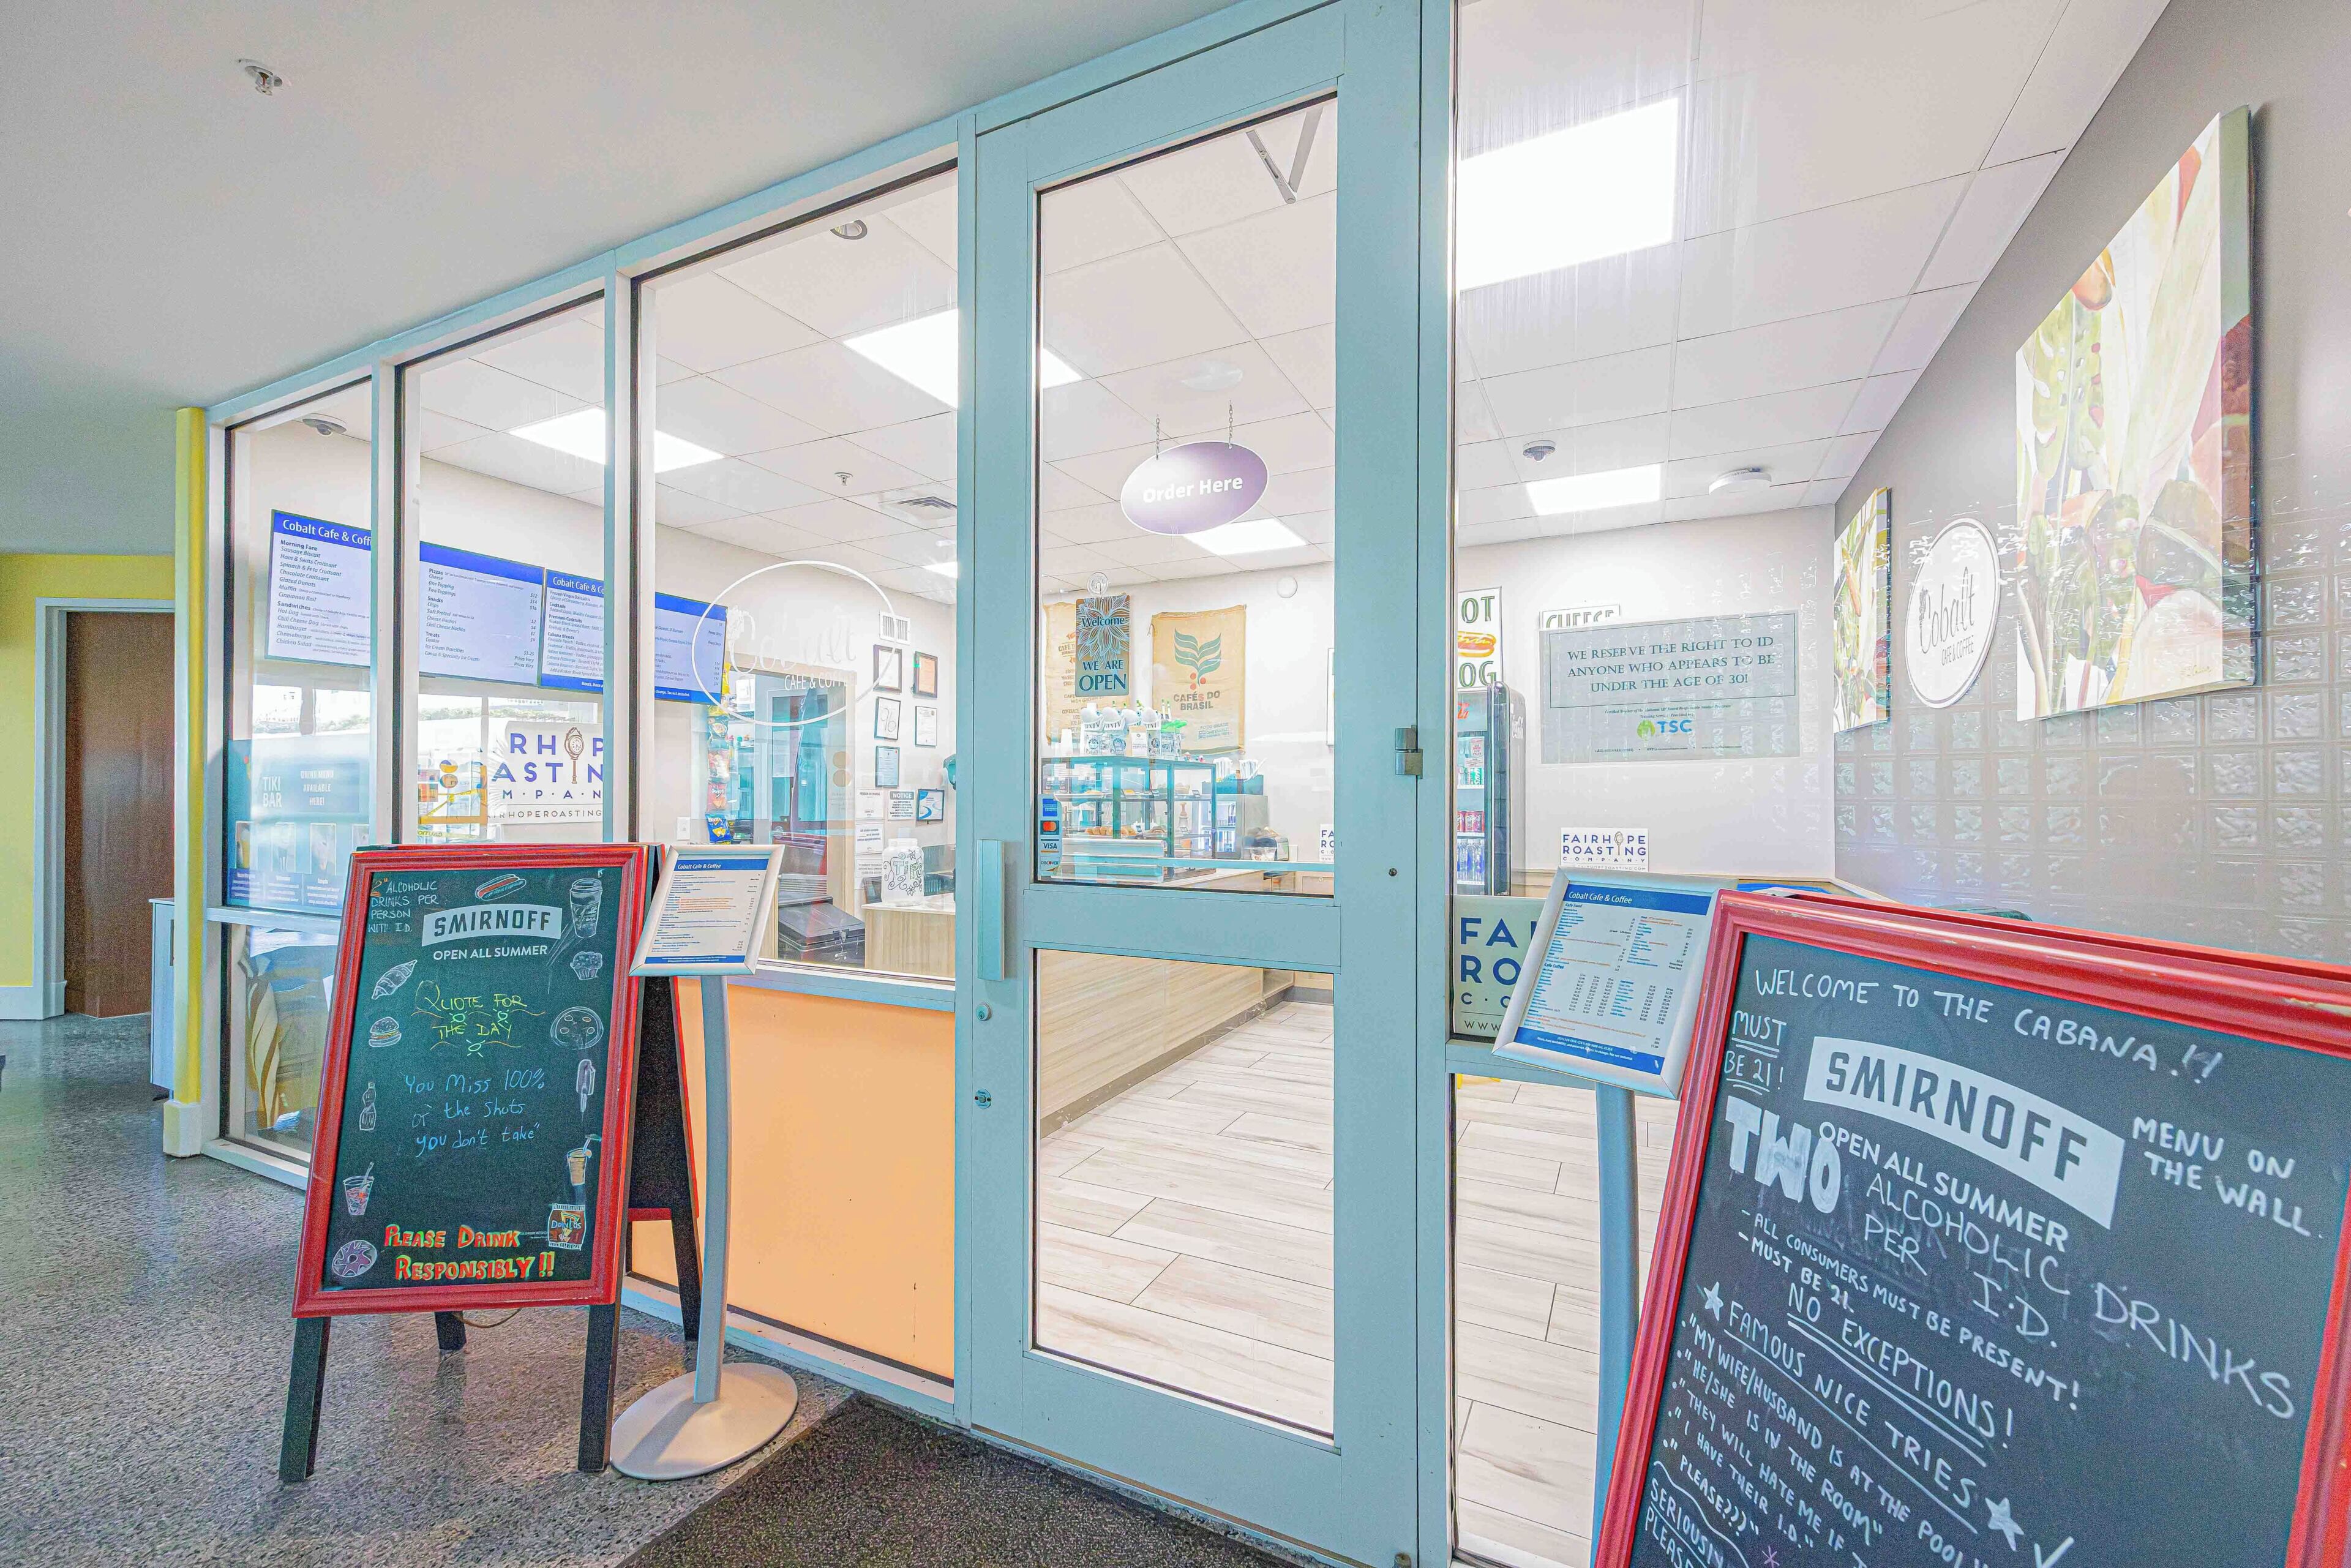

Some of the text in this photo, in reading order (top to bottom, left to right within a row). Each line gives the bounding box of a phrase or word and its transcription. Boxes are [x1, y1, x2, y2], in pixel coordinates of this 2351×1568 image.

[1142, 476, 1243, 503] Order Here
[283, 520, 349, 541] Cobalt Cafe &
[280, 539, 304, 549] Morning
[281, 546, 302, 555] Sausage
[314, 560, 337, 568] Croissant
[553, 577, 574, 588] Cobalt
[576, 582, 589, 591] Cafe
[277, 601, 310, 610] Sandwiches
[1082, 617, 1125, 627] Welcome
[277, 631, 312, 639] Cheeseburger
[1568, 637, 1773, 661] WE RESERVE THE RIGHT TO ID
[1083, 659, 1123, 670] WE ARE
[1568, 655, 1775, 677] ANYONE WHO APPEARS TO BE
[785, 675, 816, 690] CAFE &
[1079, 673, 1126, 691] OPEN
[1591, 675, 1748, 692] UNDER THE AGE OF 30!
[1174, 691, 1220, 702] CAFÉS DO
[1180, 701, 1213, 710] BRASIL
[1657, 720, 1692, 733] TSC
[263, 777, 281, 791] TIKI
[263, 793, 282, 808] BAR
[1563, 846, 1646, 855] ROASTING
[386, 881, 437, 893] ALCOHOLIC
[371, 895, 439, 907] DRINKS PER
[371, 909, 410, 920] PERSON
[434, 910, 550, 937] SMIRNOFF
[433, 945, 547, 960] OPEN ALL SUMMER
[1461, 955, 1521, 985] RO
[415, 980, 527, 1012] QUOTE FOR
[1755, 969, 1993, 1023] WELCOME TO THE
[432, 1022, 512, 1040] THE DAY
[1731, 1010, 1787, 1045] MUST
[1724, 1049, 1745, 1076] BE
[504, 1068, 544, 1090] 100%
[444, 1100, 471, 1119] the
[1826, 1051, 2088, 1181] SMIRNOFF
[416, 1135, 446, 1158] you
[452, 1128, 488, 1148] don't
[2132, 1116, 2296, 1179] MENU ON
[1819, 1121, 2069, 1253] OPEN ALL SUMMER
[2144, 1150, 2323, 1239] THE WALL.
[384, 1224, 520, 1249] PLEASE DRINK
[1865, 1213, 1927, 1276] PER
[1725, 1095, 2297, 1419] TWO ALCOHOLIC DRINKS
[1801, 1267, 1821, 1291] BE
[1786, 1233, 2080, 1410] CONSUMERS MUST BE PRESENT!
[1788, 1283, 2014, 1449] NO EXCEPTIONS!
[1729, 1300, 1976, 1509] FAMOUS NICE TRIES
[1717, 1345, 1911, 1523] WIFE/HUSBAND IS AT THE
[1746, 1409, 1760, 1432] IS
[1765, 1428, 1782, 1449] IN
[1788, 1446, 1816, 1484] THE
[1697, 1434, 1768, 1515] HAVE THEIR
[1722, 1424, 1844, 1550] WILL HATE ME IF
